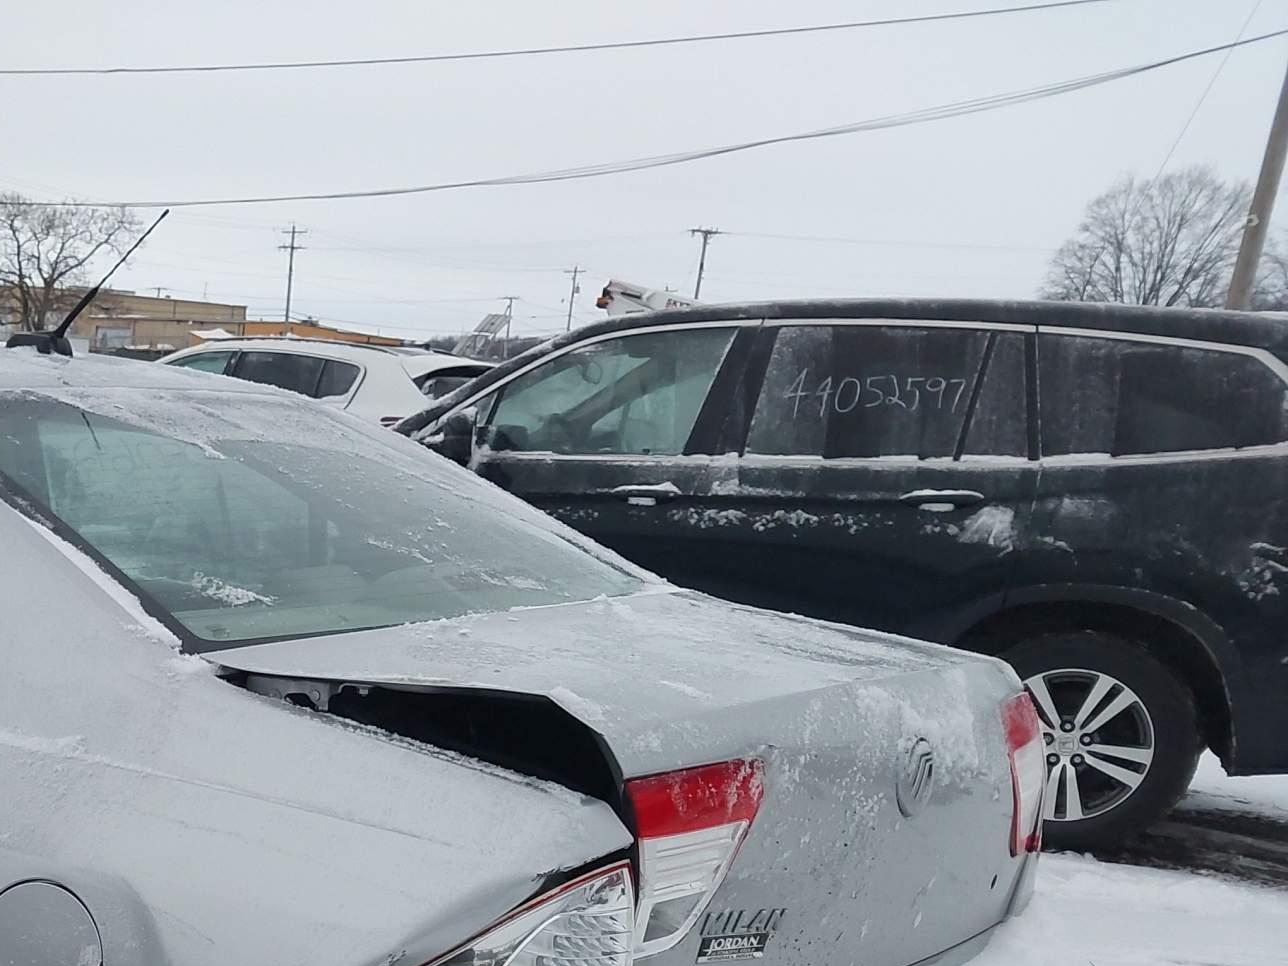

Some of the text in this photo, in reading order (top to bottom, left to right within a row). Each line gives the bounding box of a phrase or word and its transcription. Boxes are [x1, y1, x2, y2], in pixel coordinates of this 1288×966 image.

[783, 367, 966, 419] 44052597
[699, 907, 788, 936] MILAN
[705, 935, 762, 955] JORDAN
